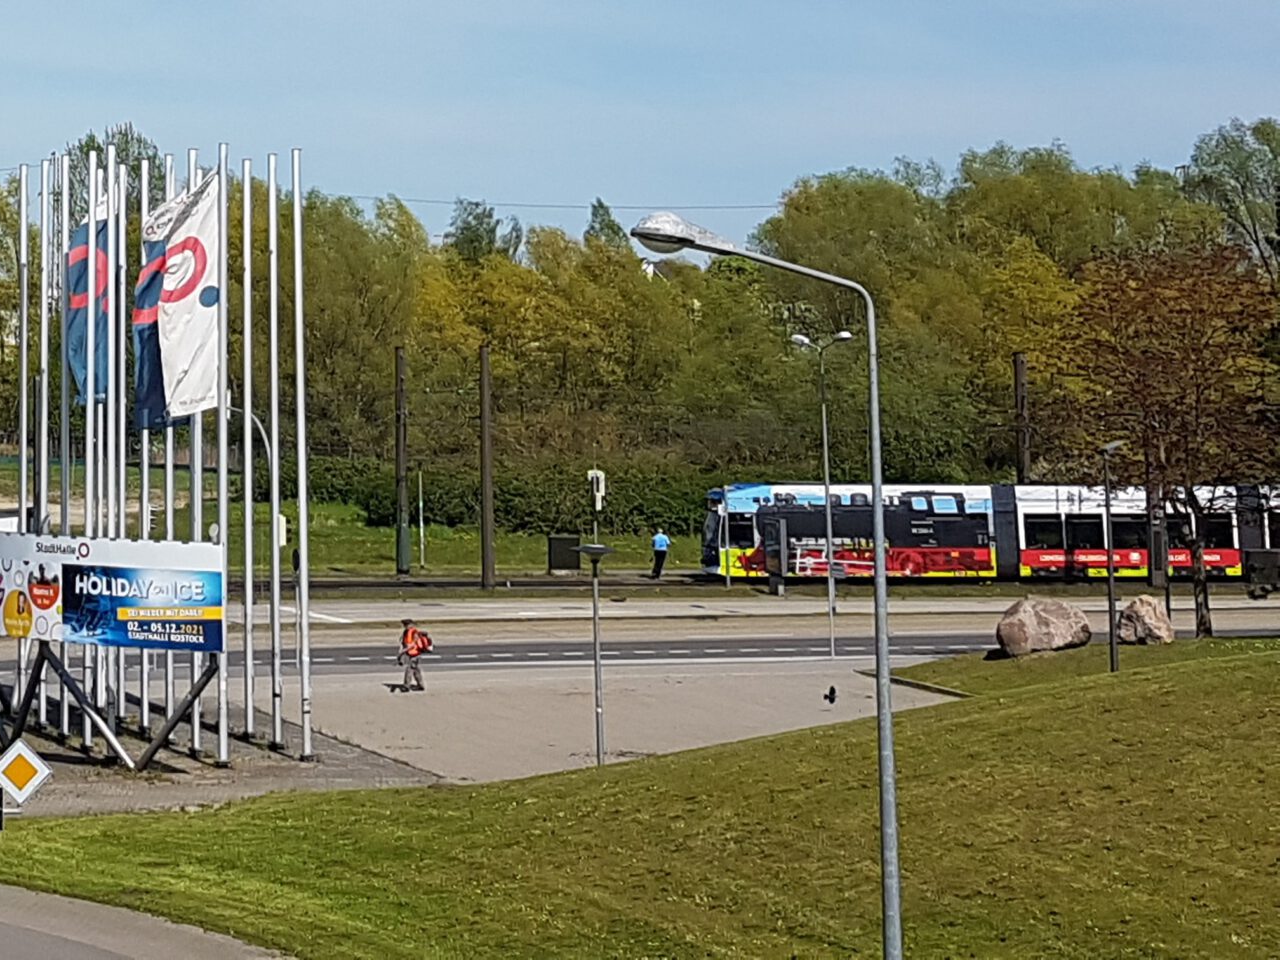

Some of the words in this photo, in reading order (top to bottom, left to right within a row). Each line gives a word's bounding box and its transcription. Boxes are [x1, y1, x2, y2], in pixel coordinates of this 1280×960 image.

[74, 572, 153, 600] HOLIDAY
[172, 580, 206, 604] ICE
[127, 621, 141, 632] 02.
[150, 622, 204, 635] 05.12.2021
